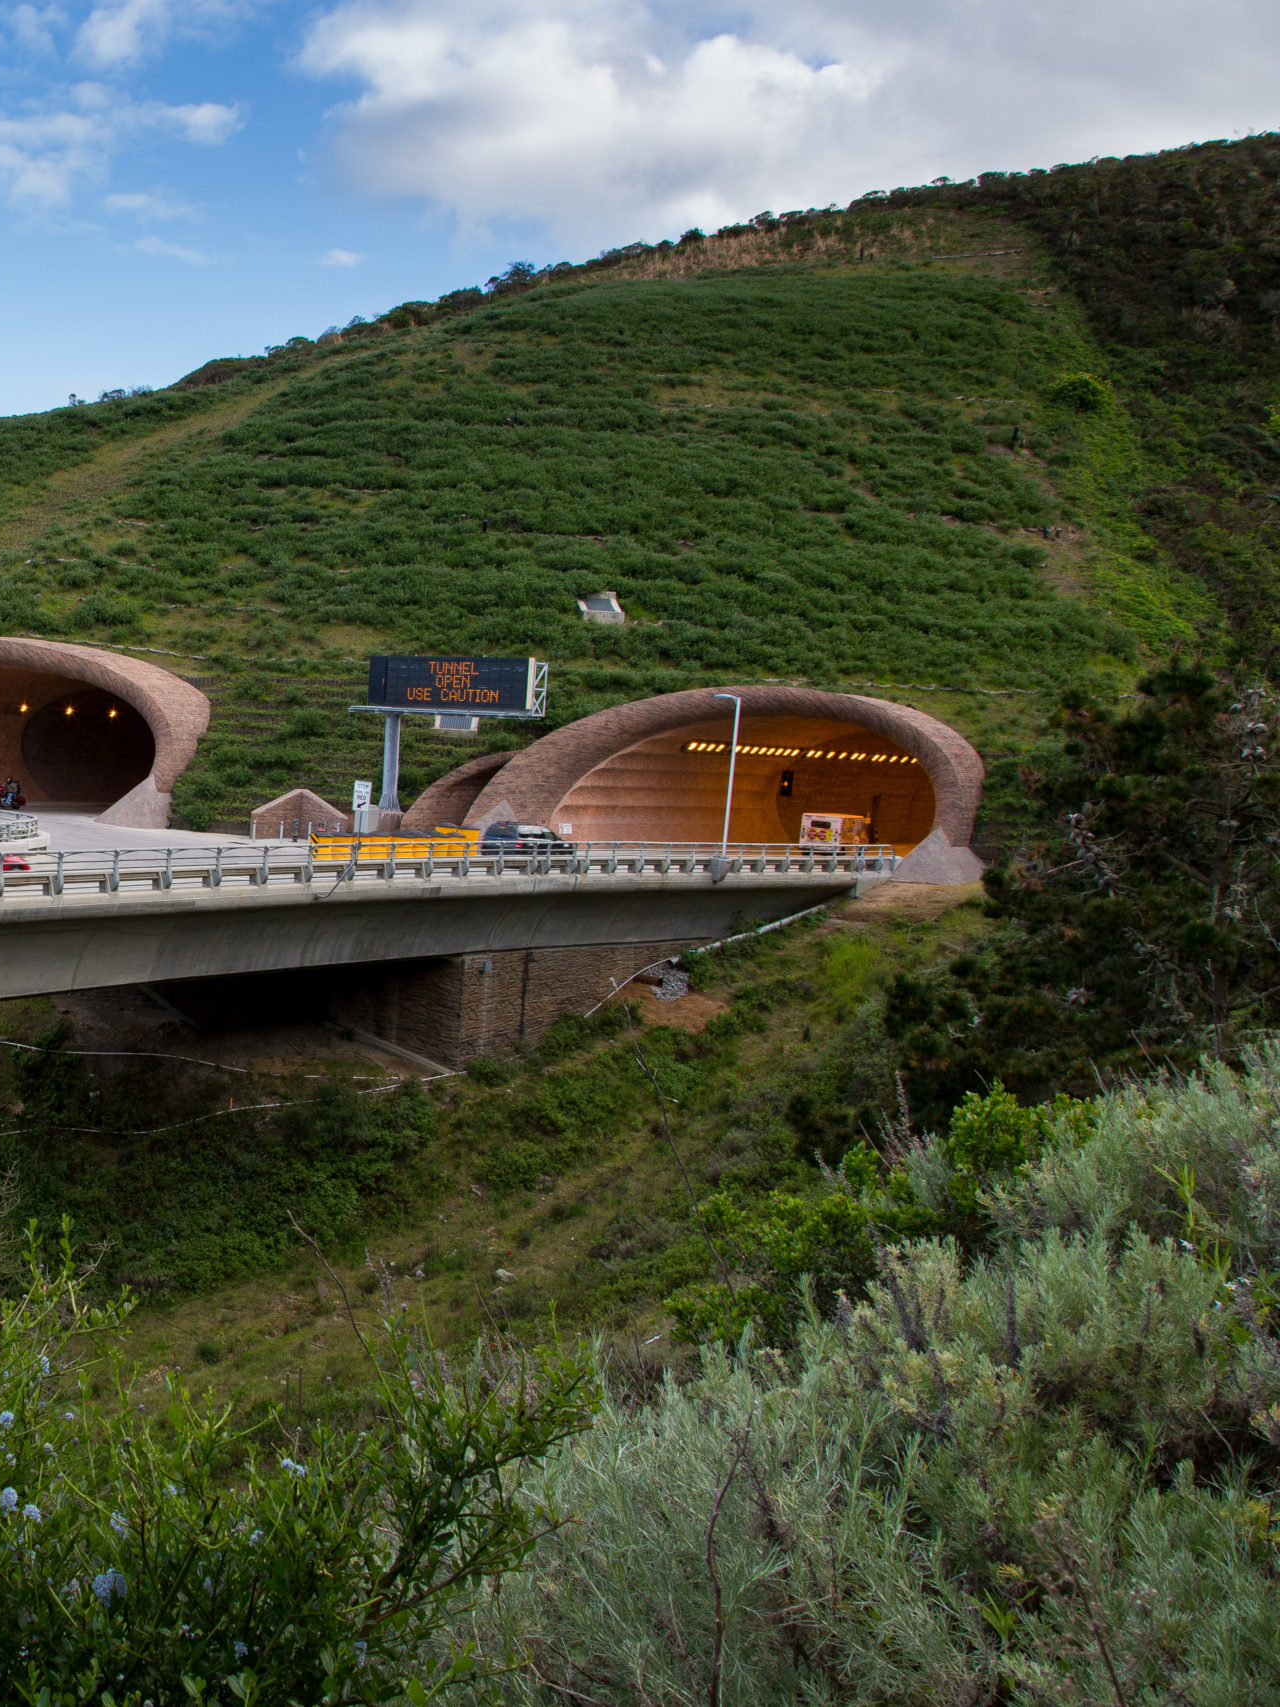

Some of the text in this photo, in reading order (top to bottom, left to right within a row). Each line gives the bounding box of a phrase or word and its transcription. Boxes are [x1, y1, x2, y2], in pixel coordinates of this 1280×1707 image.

[429, 661, 479, 675] TUNNEL
[435, 675, 470, 688] OPEN
[407, 688, 499, 703] USE CAUTION
